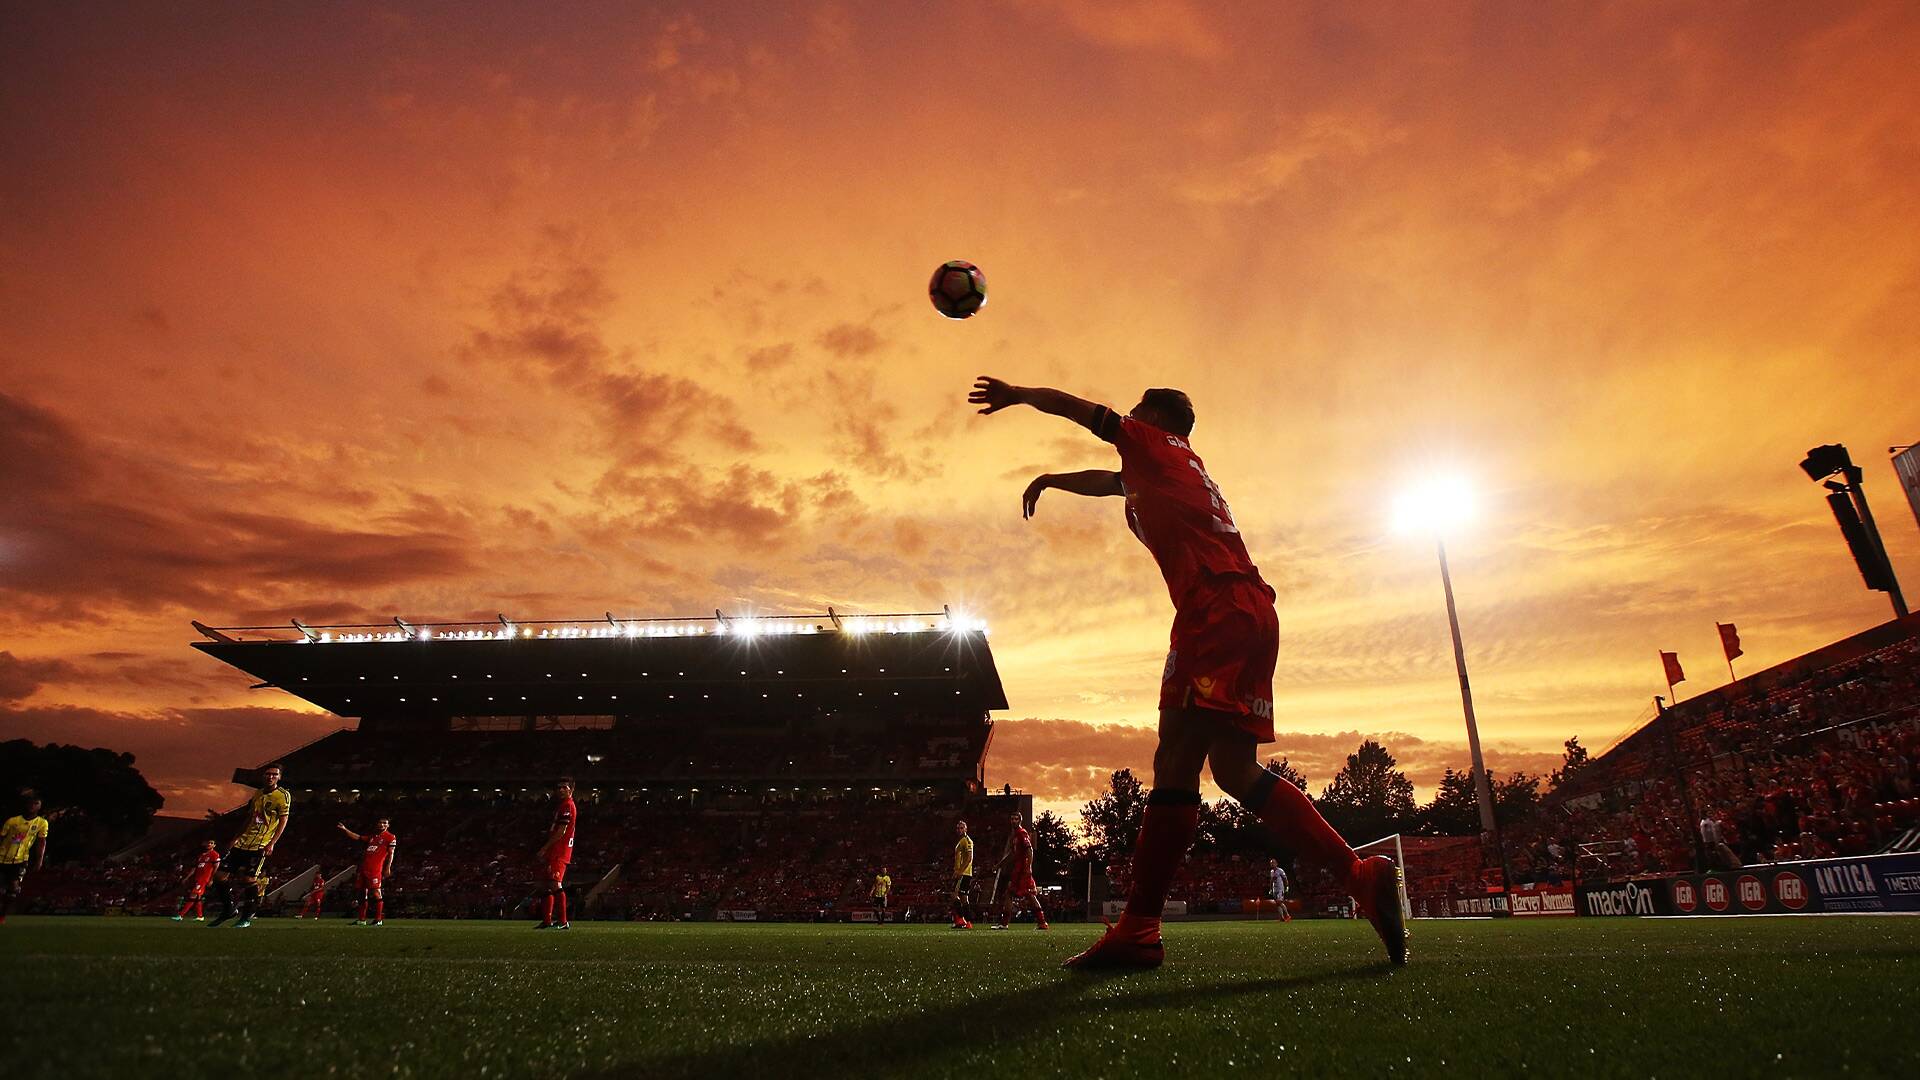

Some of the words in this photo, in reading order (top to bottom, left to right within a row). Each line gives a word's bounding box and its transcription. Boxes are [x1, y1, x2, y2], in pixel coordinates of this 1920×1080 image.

[1815, 862, 1877, 895] ANTICA
[1586, 882, 1656, 915] macron
[1676, 886, 1694, 904] IGA
[1706, 884, 1725, 903] IGA
[1740, 882, 1761, 902] IGA
[1778, 879, 1802, 900] IGA
[1511, 893, 1540, 911] Harvey
[1541, 891, 1575, 910] Norman
